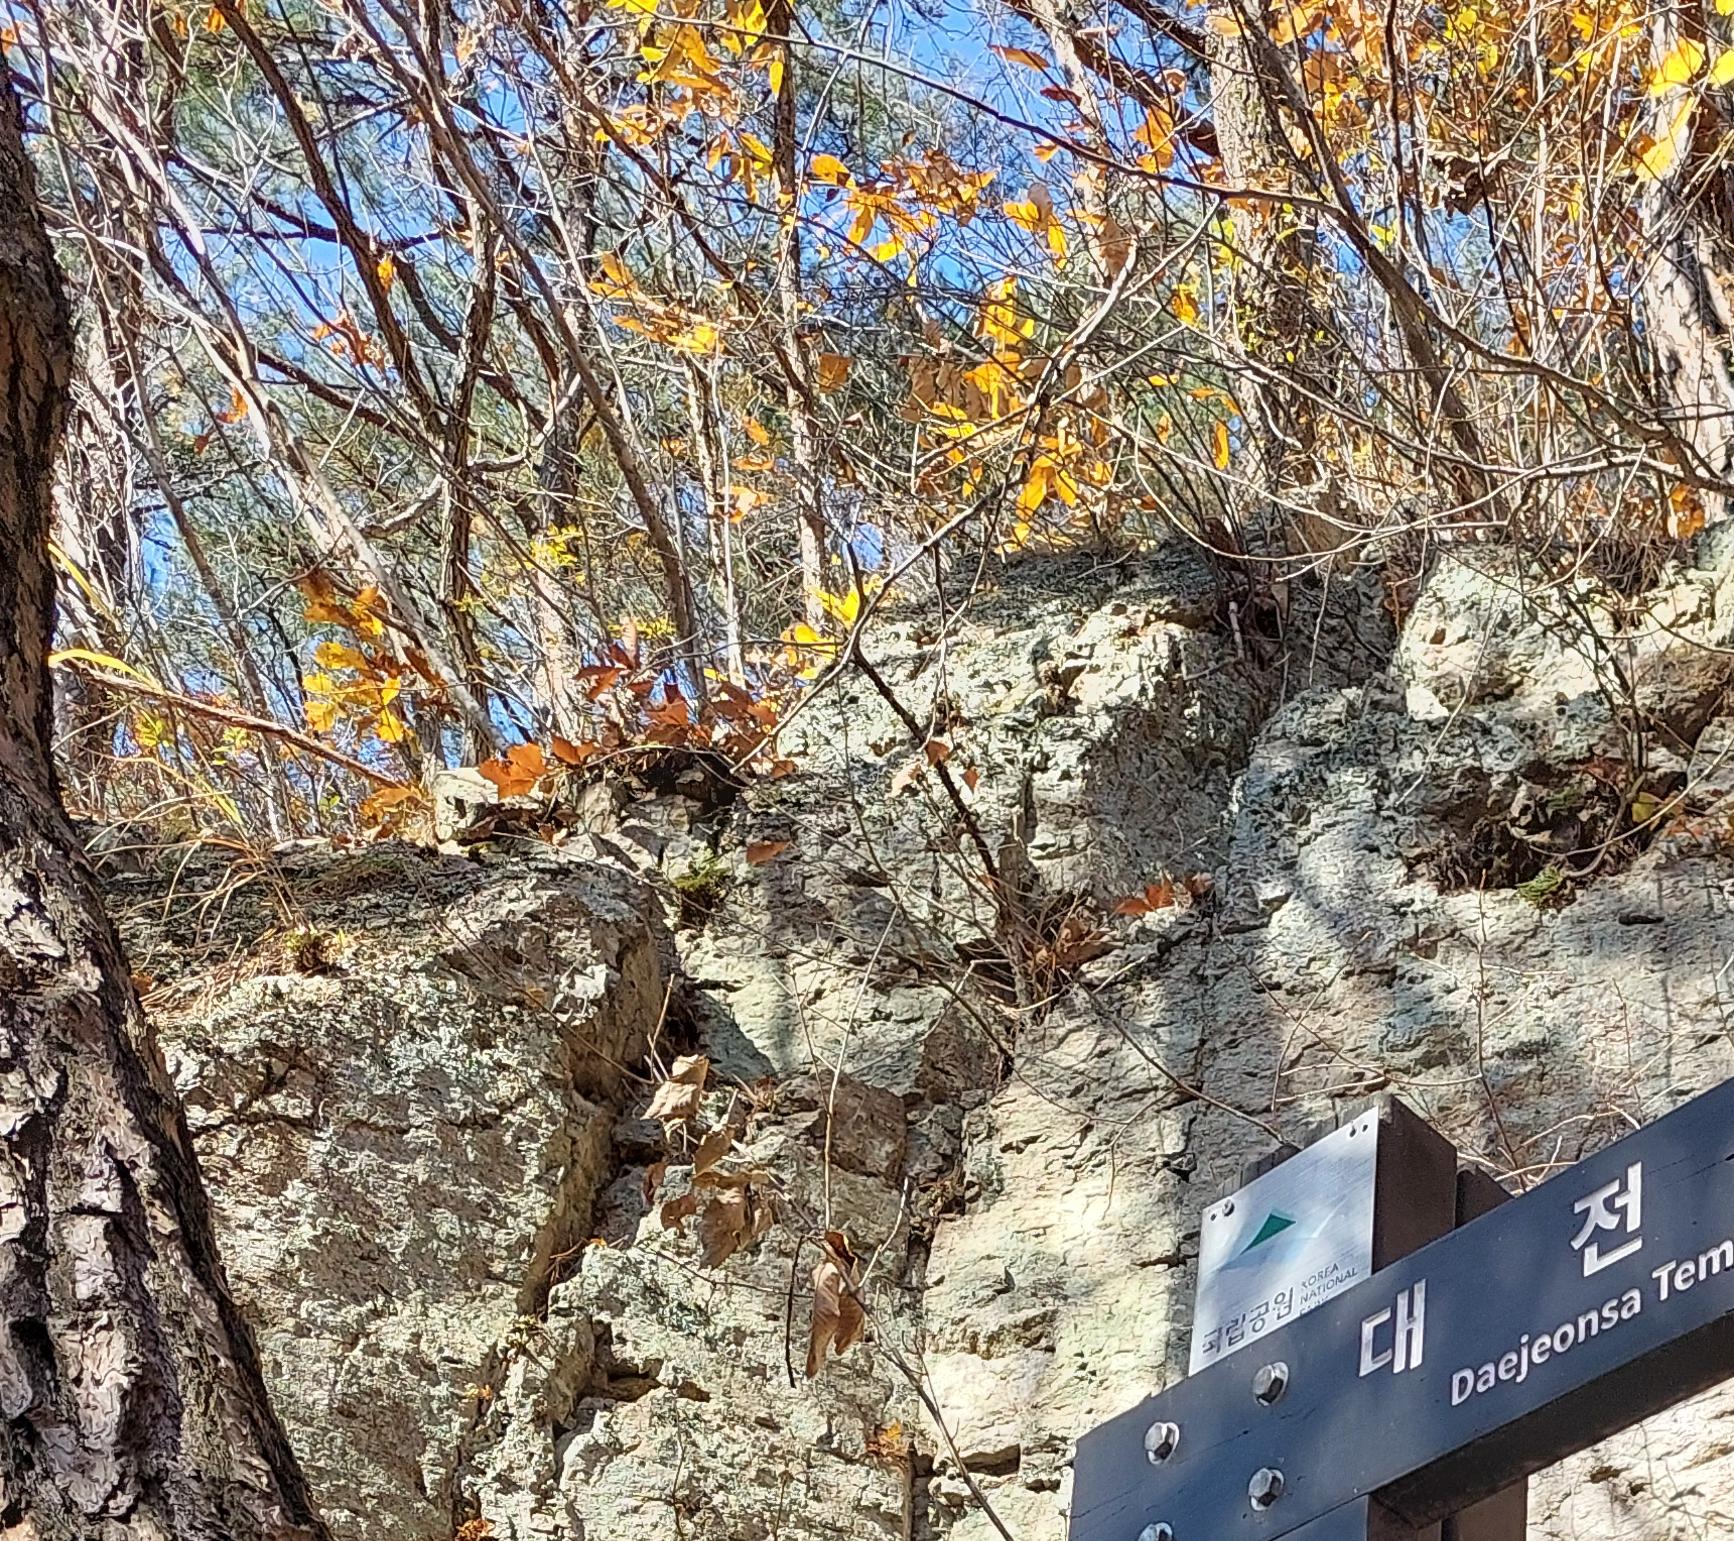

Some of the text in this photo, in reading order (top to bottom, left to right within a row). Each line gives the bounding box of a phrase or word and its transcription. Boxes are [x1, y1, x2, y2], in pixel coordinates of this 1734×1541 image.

[1300, 1267, 1358, 1305] NATIONAL
[1202, 1287, 1294, 1353] 국립공원
[1450, 1287, 1642, 1406] Daejeonsa
